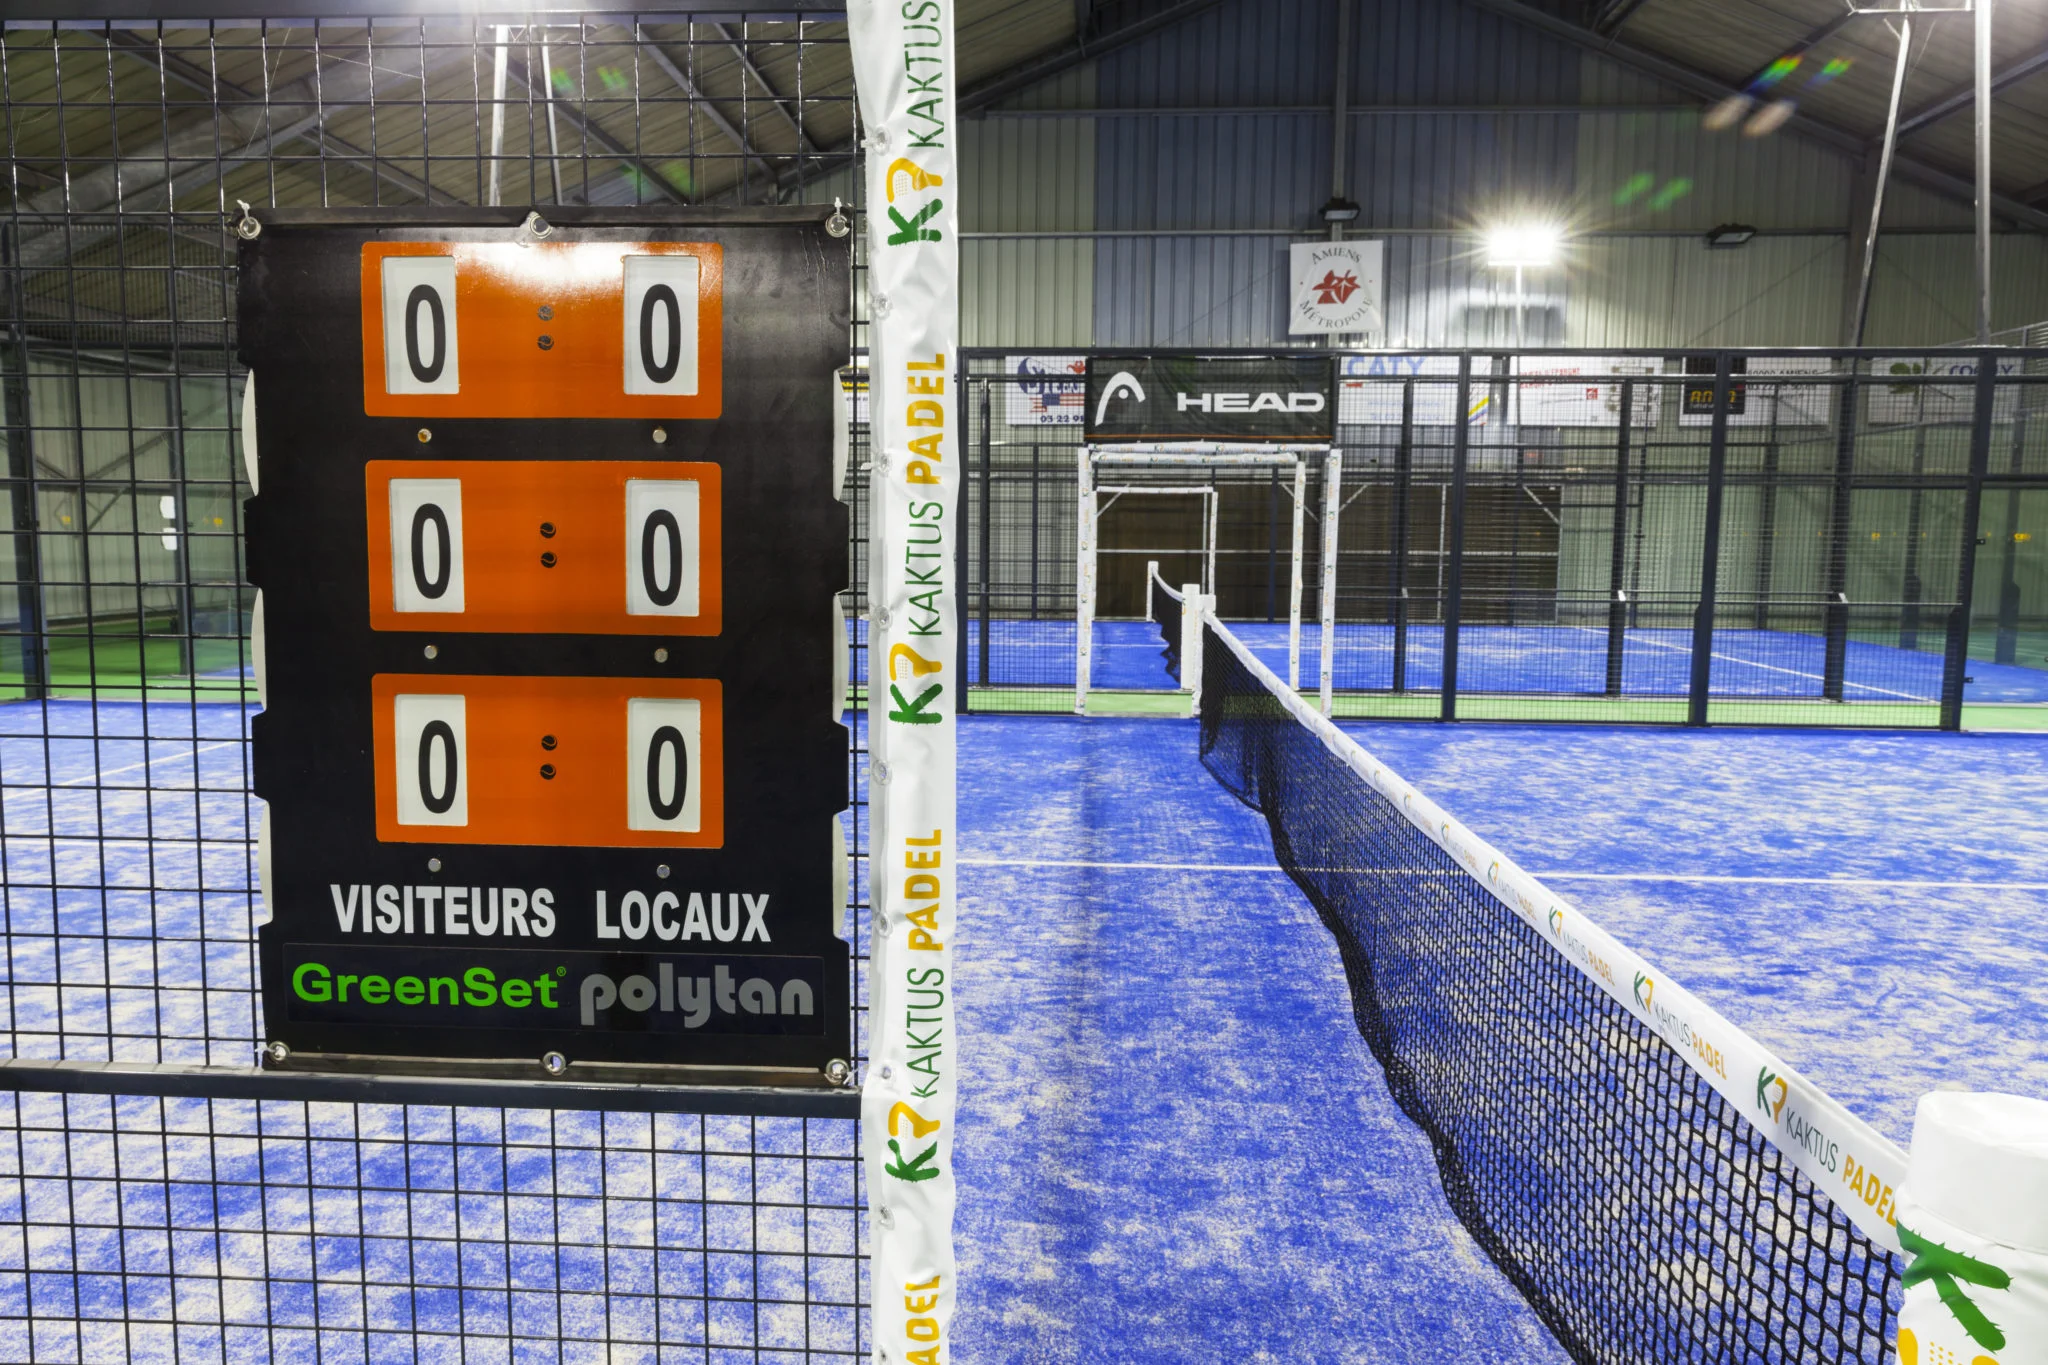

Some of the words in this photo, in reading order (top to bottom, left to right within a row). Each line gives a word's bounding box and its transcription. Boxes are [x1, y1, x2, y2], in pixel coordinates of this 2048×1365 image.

[901, 0, 945, 148] KAKTUS
[1312, 247, 1362, 265] AMIENS
[405, 284, 446, 383] 0
[639, 284, 681, 383] 0
[905, 353, 946, 485] PADEL
[1176, 392, 1326, 413] HEAD
[411, 503, 451, 600] 0
[641, 509, 683, 607] 0
[905, 501, 944, 636] KAKTUS
[418, 719, 458, 814] 0
[646, 725, 688, 821] 0
[330, 884, 556, 938] VISITEURS
[596, 890, 771, 942] LOCAUX
[904, 828, 945, 952] PADEL
[580, 963, 815, 1028] polytan
[906, 968, 945, 1098] KAKTUS
[1692, 1031, 1727, 1081] PADEL
[1786, 1106, 1838, 1173] KAKTUS
[1842, 1153, 1897, 1228] PADEL
[904, 1275, 941, 1365] ADEL
